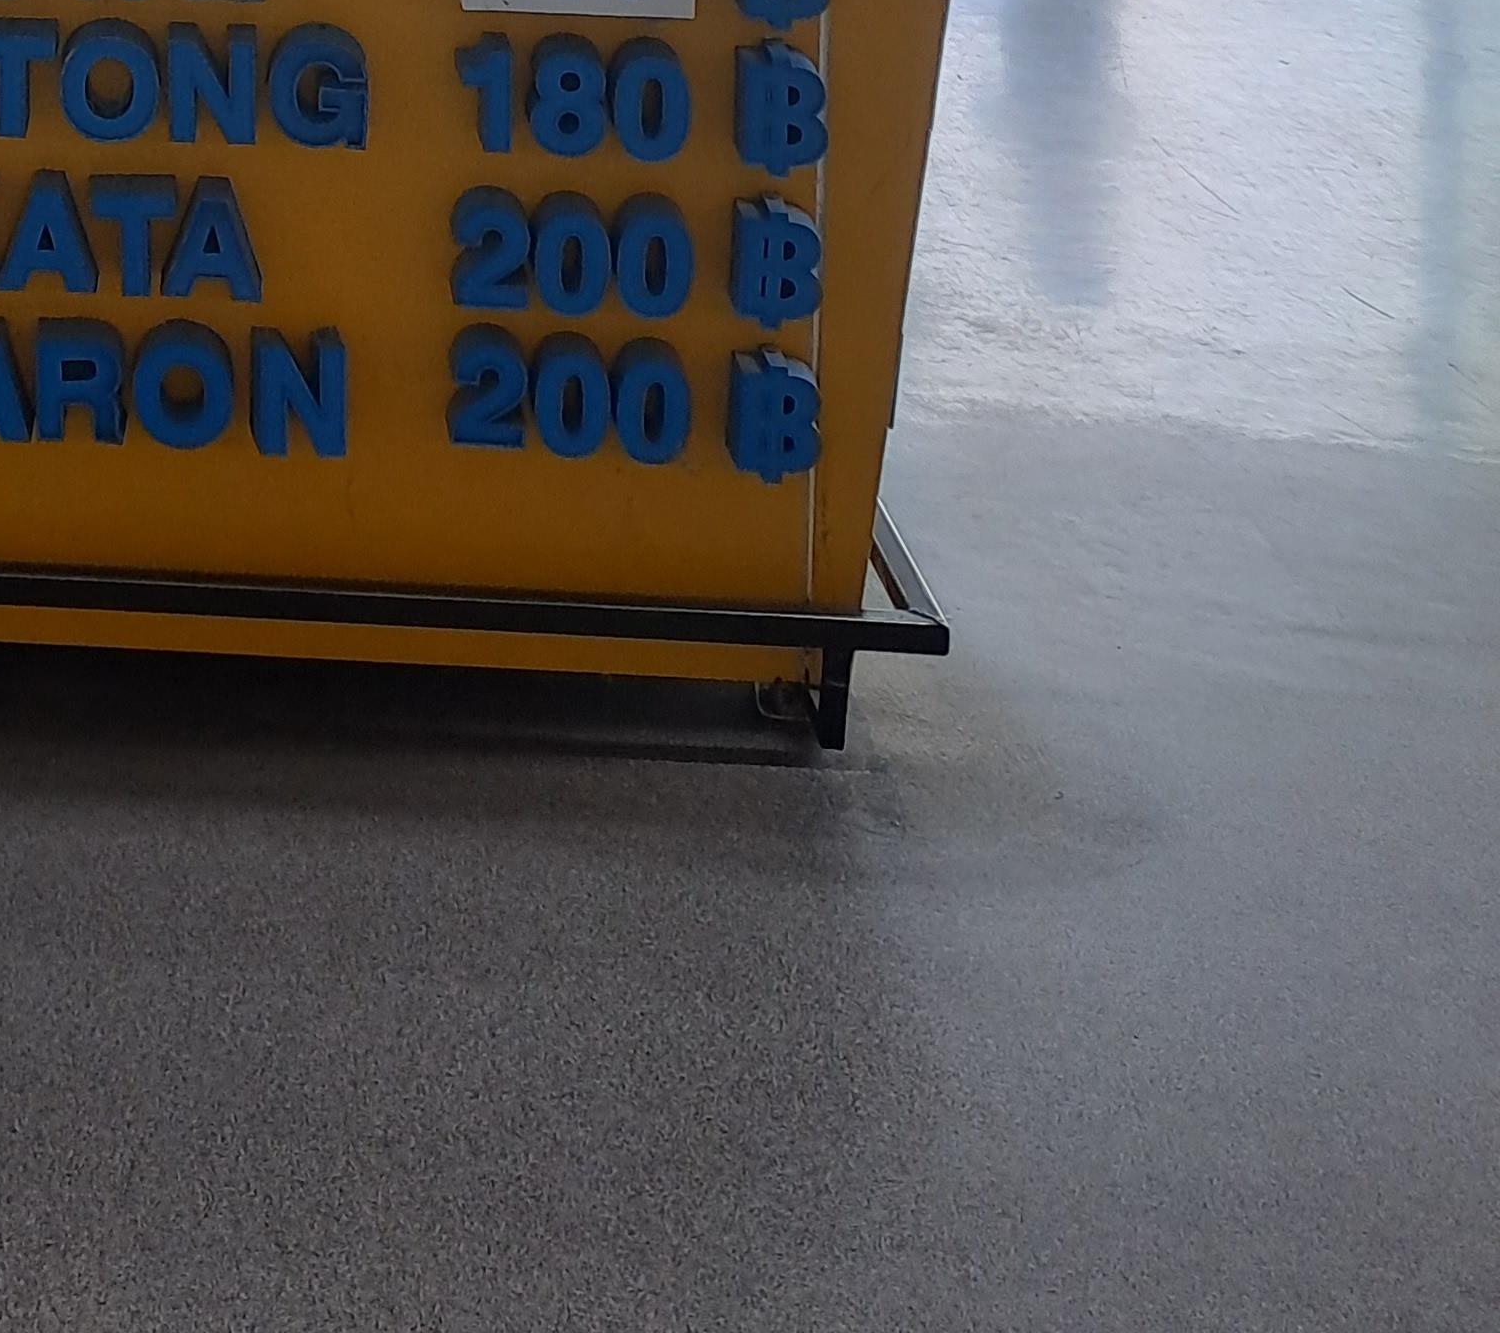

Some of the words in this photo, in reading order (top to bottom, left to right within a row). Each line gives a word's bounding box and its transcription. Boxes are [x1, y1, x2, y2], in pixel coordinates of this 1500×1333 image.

[454, 31, 691, 162] 180
[449, 185, 693, 318] 200
[445, 321, 692, 461] 200
